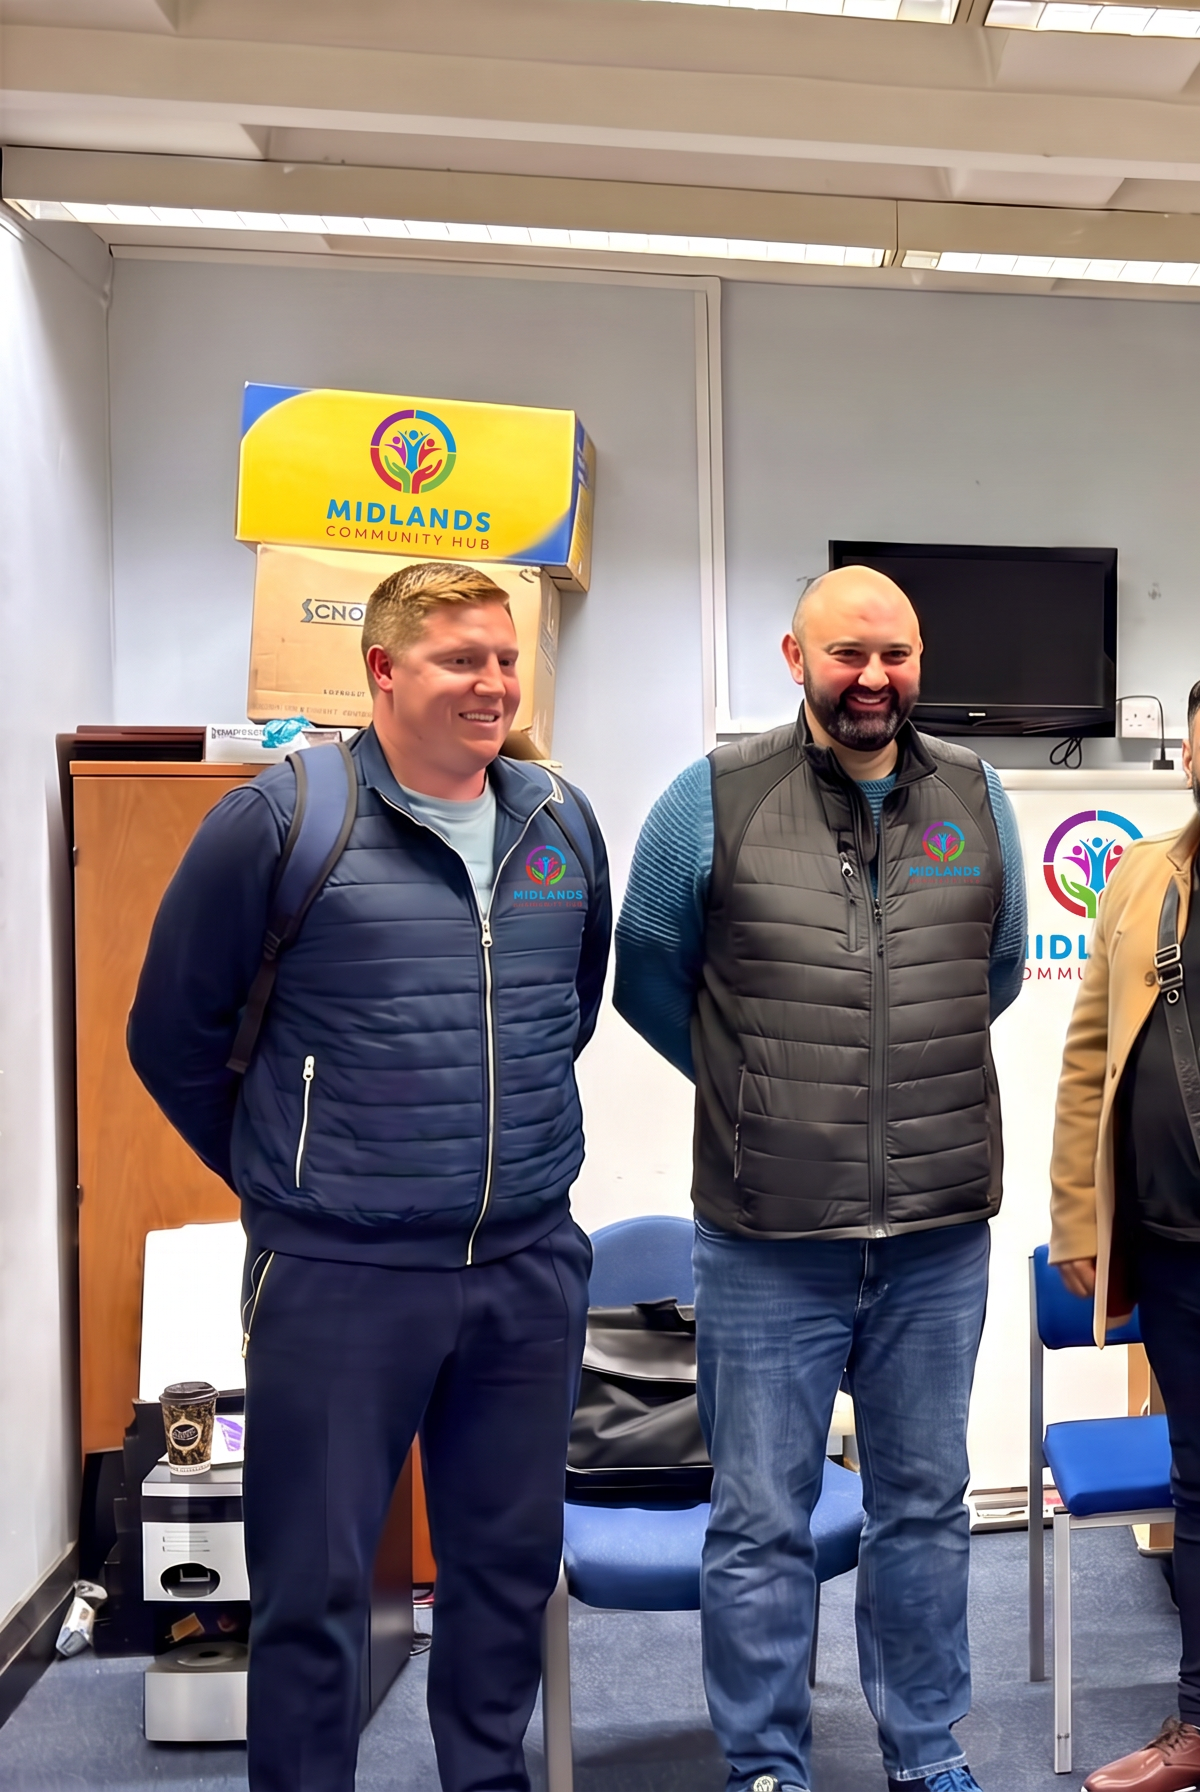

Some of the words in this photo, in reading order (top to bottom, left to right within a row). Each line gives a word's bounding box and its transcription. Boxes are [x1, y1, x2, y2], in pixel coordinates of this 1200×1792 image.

[326, 499, 491, 533] MIDLANDS
[326, 525, 442, 546] COMMUNITY
[452, 536, 490, 550] HUB
[909, 866, 981, 877] MIDLANDS
[513, 890, 583, 900] MIDLANDS
[1025, 934, 1090, 960] IDL
